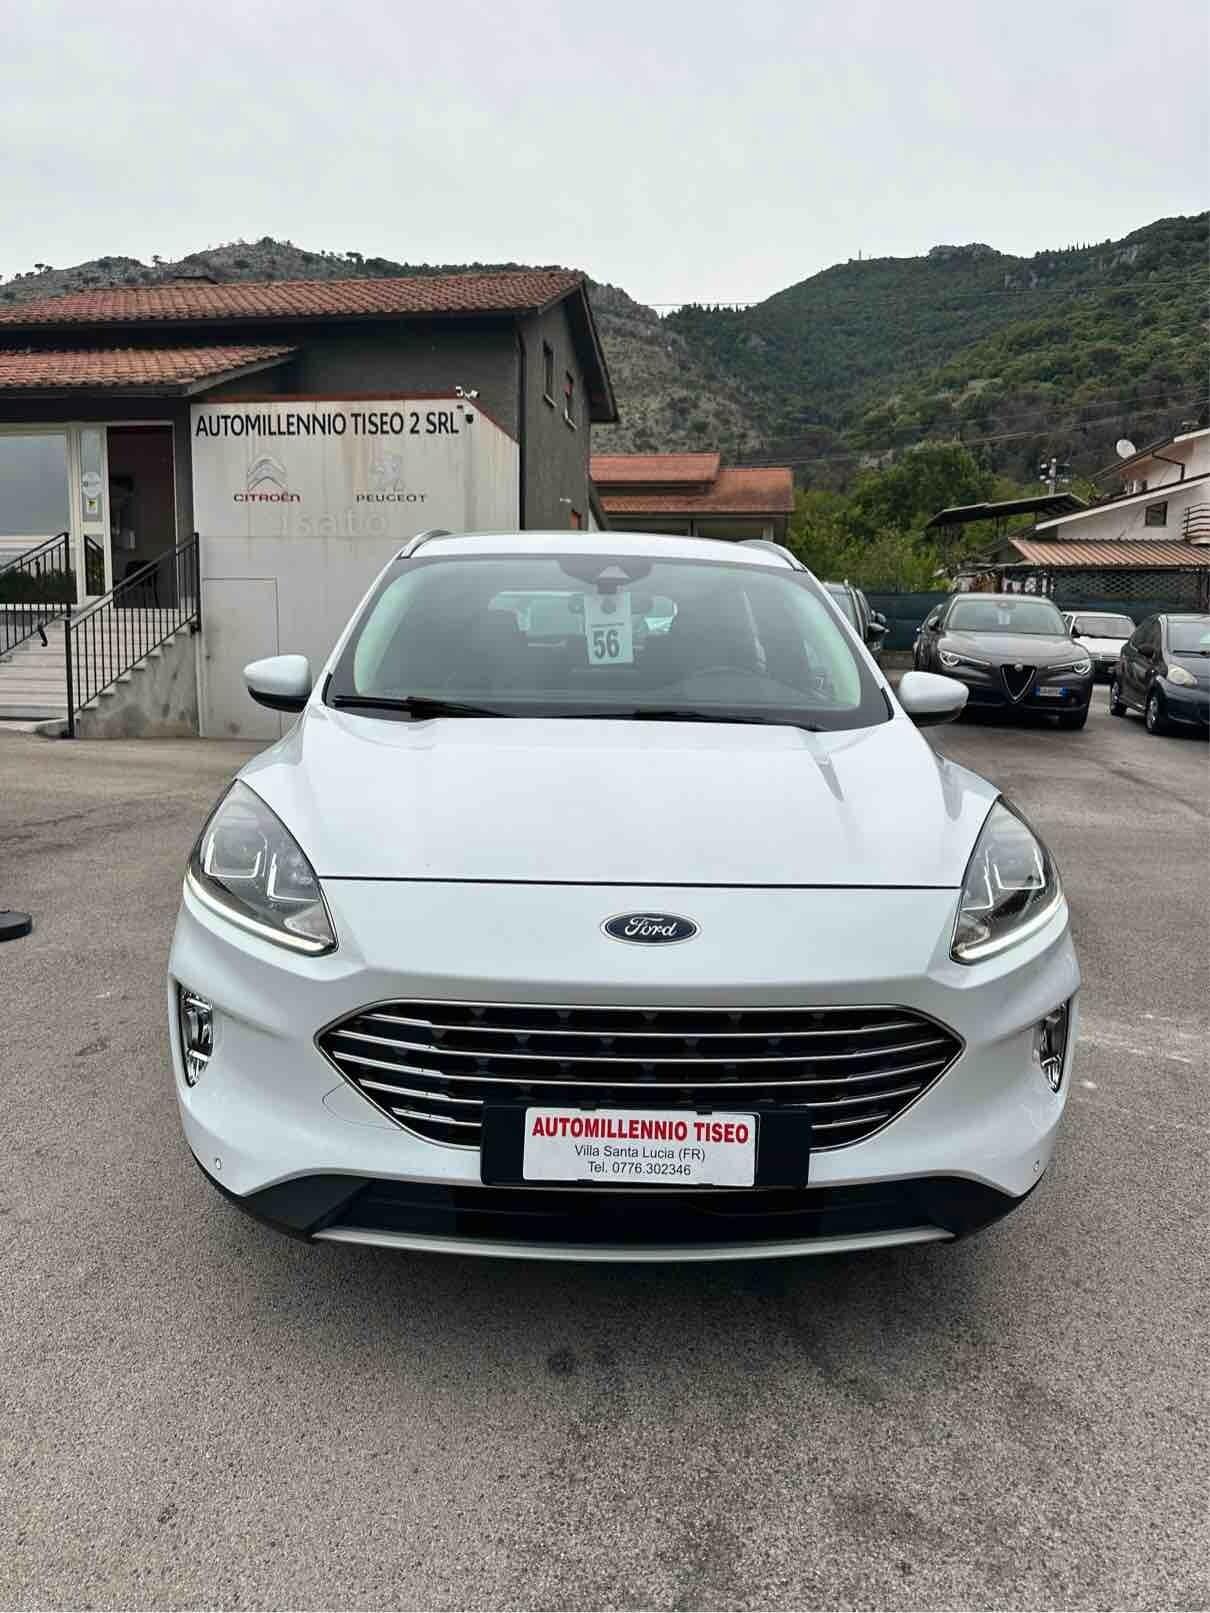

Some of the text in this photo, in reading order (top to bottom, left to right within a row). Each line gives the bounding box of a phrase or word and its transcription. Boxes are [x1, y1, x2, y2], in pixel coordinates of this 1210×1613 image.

[196, 411, 459, 436] AUTOMILLENNIO TISEO 2 SRL
[356, 494, 426, 502] PEUGEOT
[592, 629, 619, 658] 56
[624, 916, 677, 936] Ford
[532, 1117, 749, 1144] AUTOMILLENNIO TISEO
[575, 1144, 706, 1162] Villa Santa Lucia (FR)
[588, 1161, 691, 1176] Tel. 0776.302346
